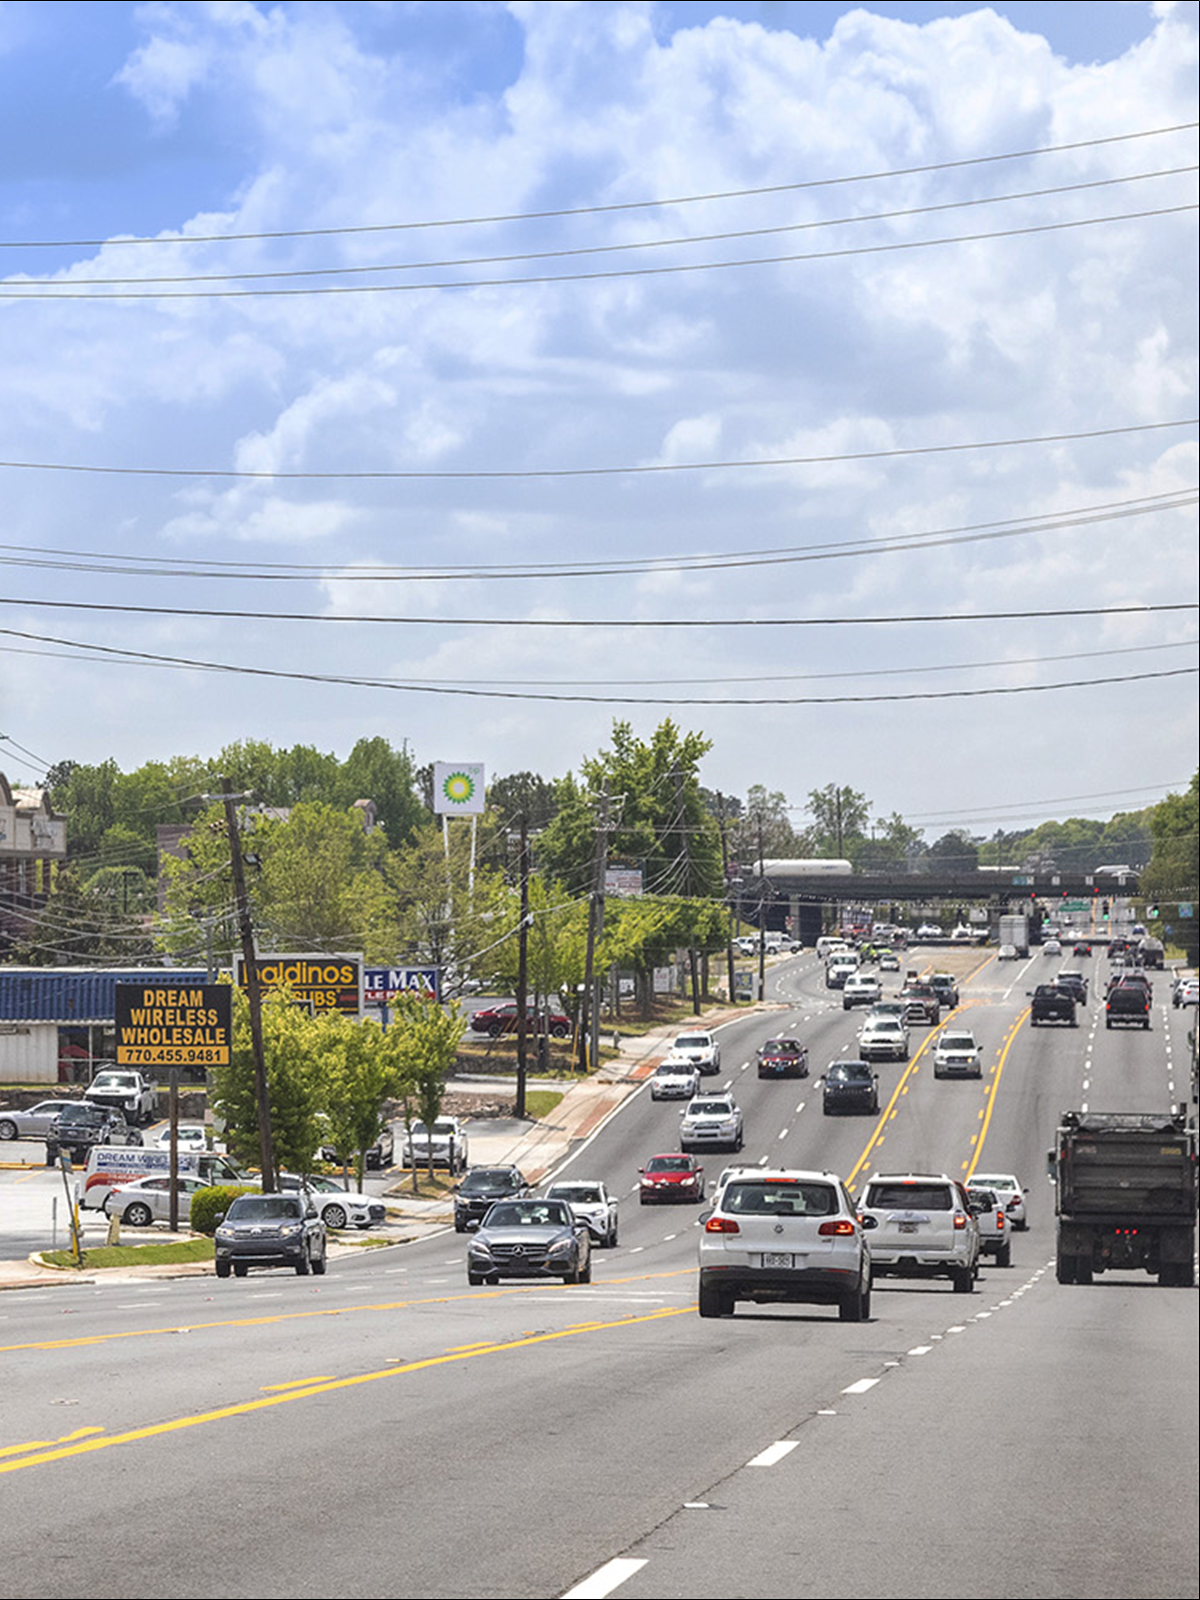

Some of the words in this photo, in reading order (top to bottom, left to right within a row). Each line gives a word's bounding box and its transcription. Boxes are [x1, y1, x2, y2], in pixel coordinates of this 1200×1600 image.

[389, 971, 434, 992] MAX
[143, 989, 203, 1007] DREAM
[130, 1008, 218, 1026] WIRELESS
[121, 1028, 226, 1045] WHOLESALE
[126, 1050, 220, 1062] 770.455.9481
[97, 1152, 135, 1163] DREAM
